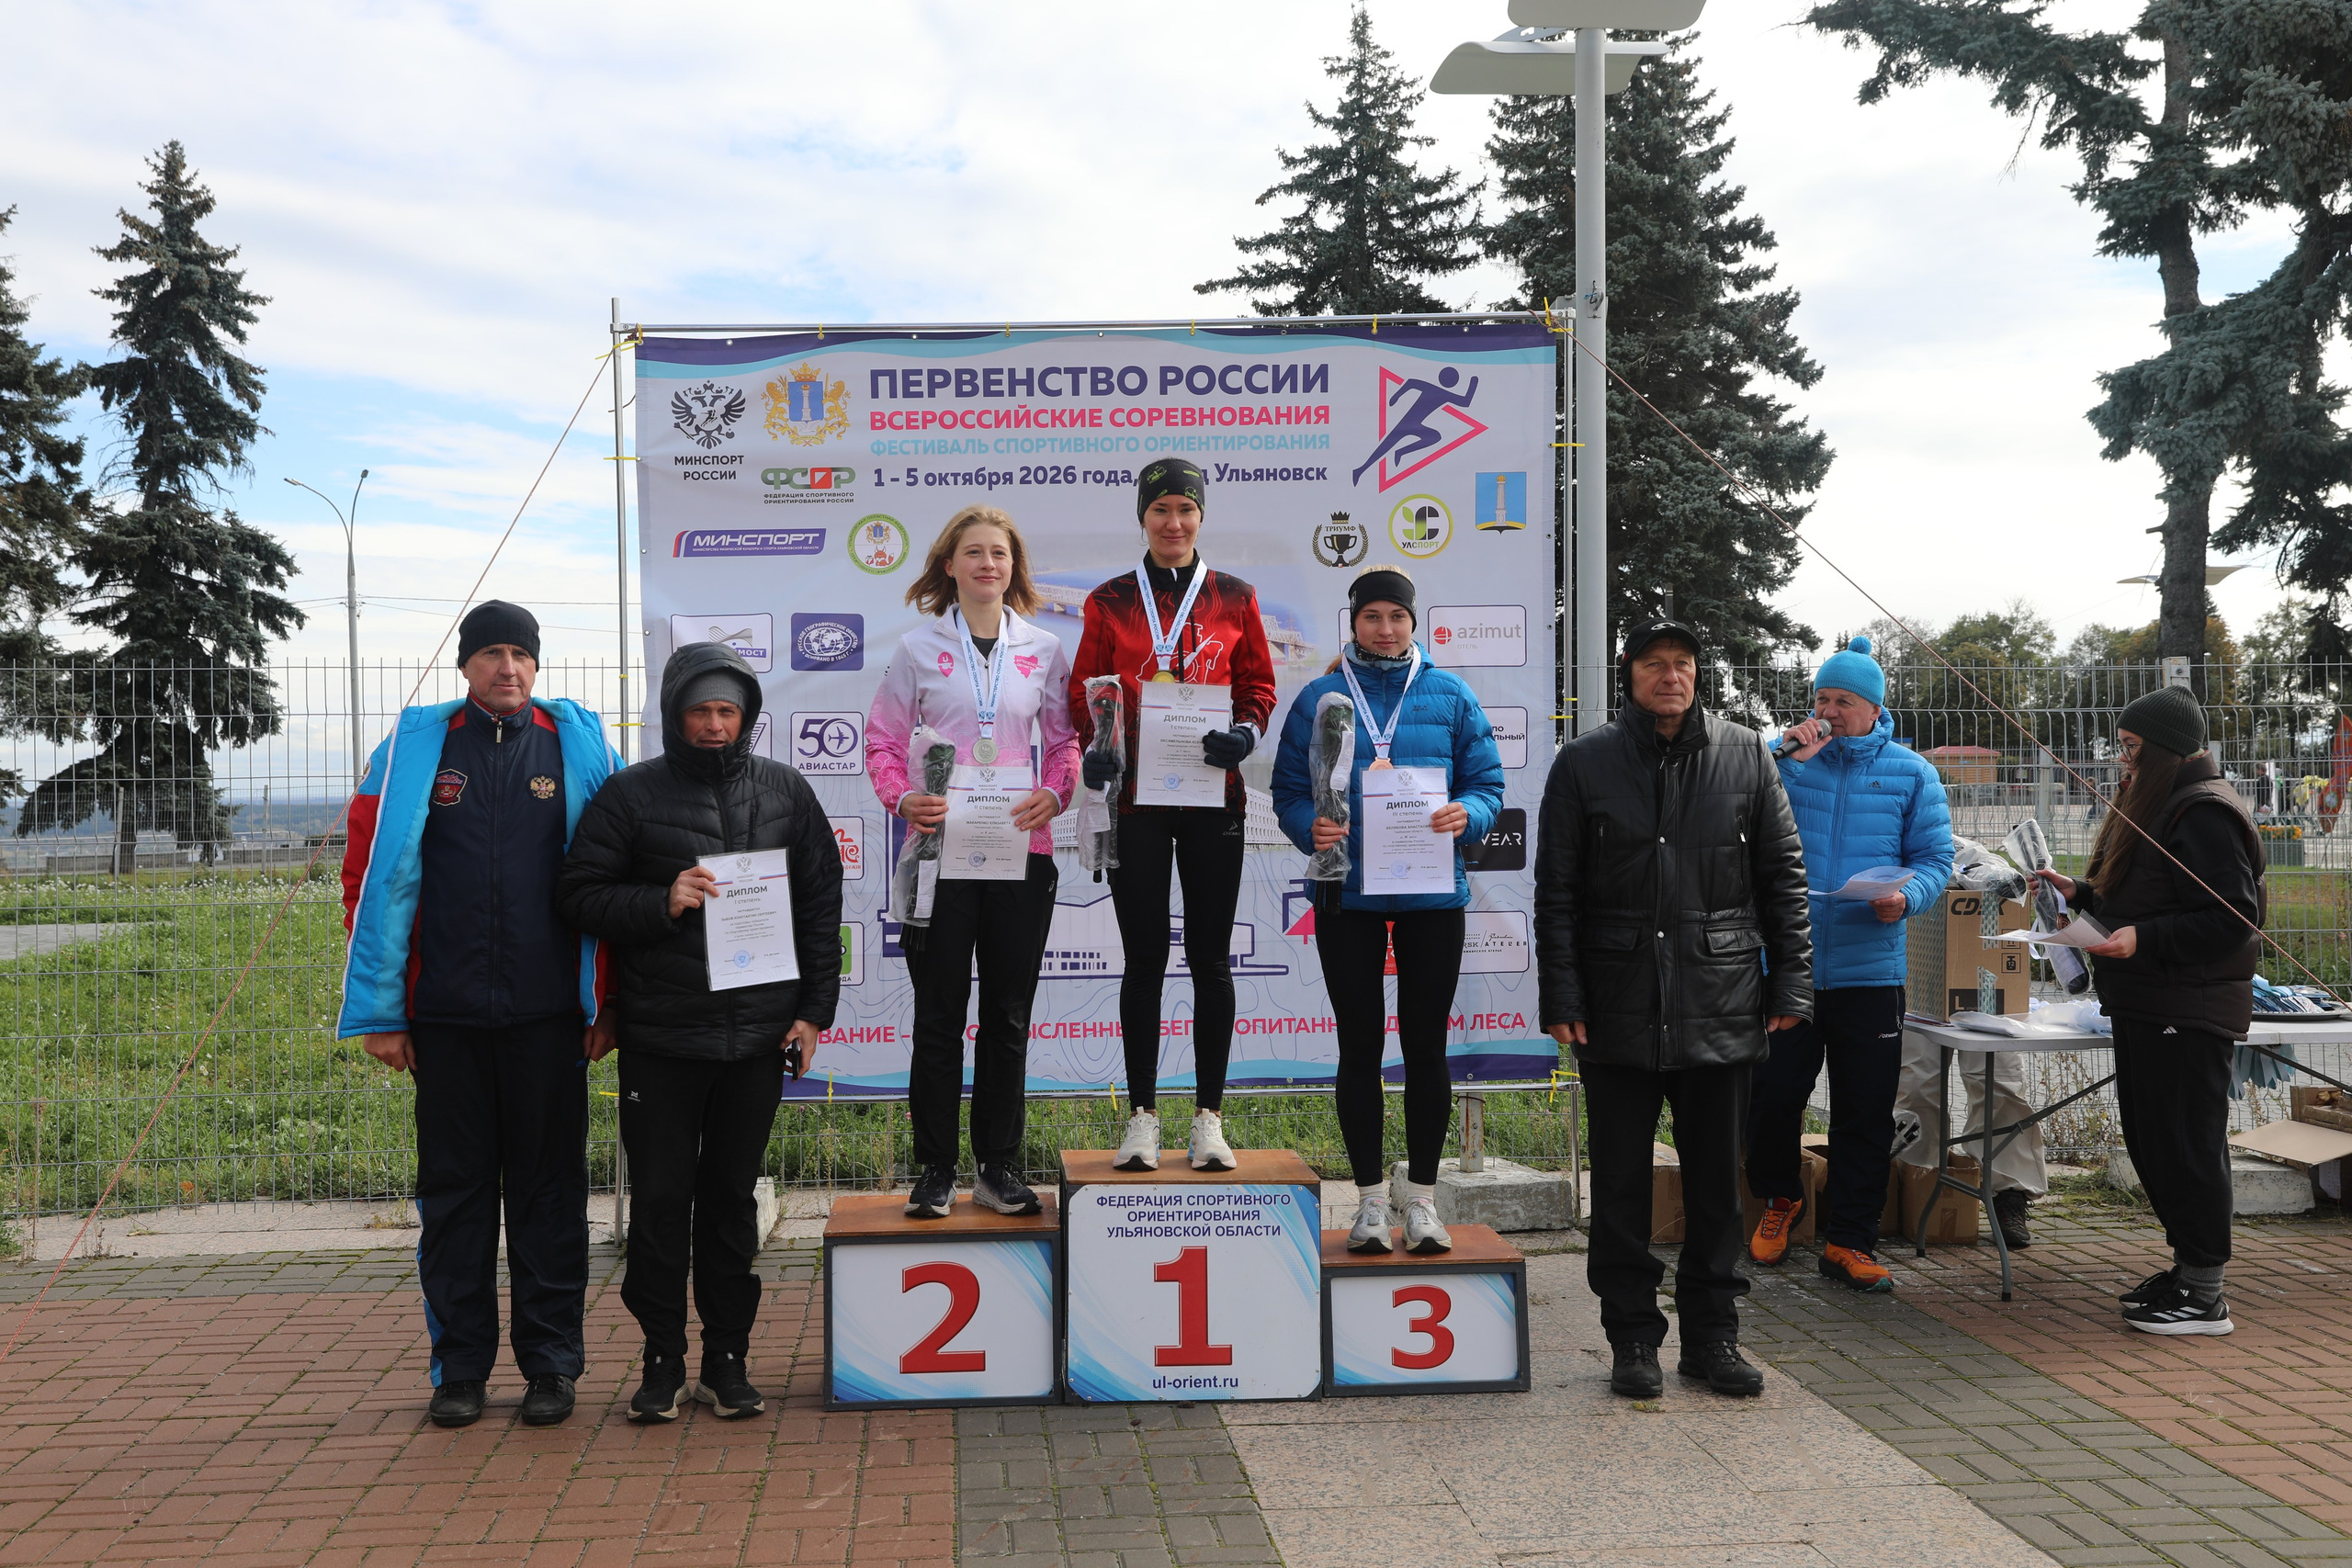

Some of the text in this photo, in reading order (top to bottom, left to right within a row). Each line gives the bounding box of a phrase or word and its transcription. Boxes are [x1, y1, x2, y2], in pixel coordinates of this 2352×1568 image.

[870, 364, 1329, 400] ПЕРВЕНСТВО РОССИИ
[870, 404, 1329, 431] ВСЕРОССИЙСКИЕ СОРЕВНОВАНИЯ
[870, 434, 1329, 457] ФЕСТИВАЛЬ СПОРТИВНОГО ОРИЕНТИРОВАНИЯ
[673, 455, 745, 467] МИНСПОРТ
[684, 470, 736, 481] РОССИИ
[924, 466, 1013, 491] октября
[1019, 465, 1078, 485] 2026
[1082, 468, 1138, 487] года,
[1214, 463, 1329, 483] Ульяновск
[693, 533, 820, 547] МИНСПОРТ
[797, 630, 806, 652] РУССКОЕ
[804, 622, 846, 632] ГЕОГРАФИЧЕСКОЕ
[1457, 623, 1521, 638] azimut
[804, 653, 830, 662] ОСНОВАНО
[1163, 714, 1206, 724] ДИПЛОМ
[798, 762, 856, 771] АВИАСТАР
[967, 795, 1011, 804] ДИПЛОМ
[1385, 800, 1429, 810] ДИПЛОМ
[727, 886, 767, 898] ДИПЛОМ
[1951, 897, 2007, 916] CDK
[1470, 1012, 1526, 1031] ЛЕСА
[1096, 1194, 1291, 1209] ФЕДЕРАЦИЯ СПОРТИВНОГО
[1127, 1210, 1261, 1222] ОРИЕНТИРОВАНИЯ
[1107, 1223, 1281, 1237] УЛЬЯНОВСКОЙ ОБЛАСТИ
[1153, 1246, 1233, 1367] 1
[899, 1260, 986, 1375] 2
[1391, 1284, 1454, 1371] 3
[1152, 1375, 1238, 1389] ul-orient.ru
